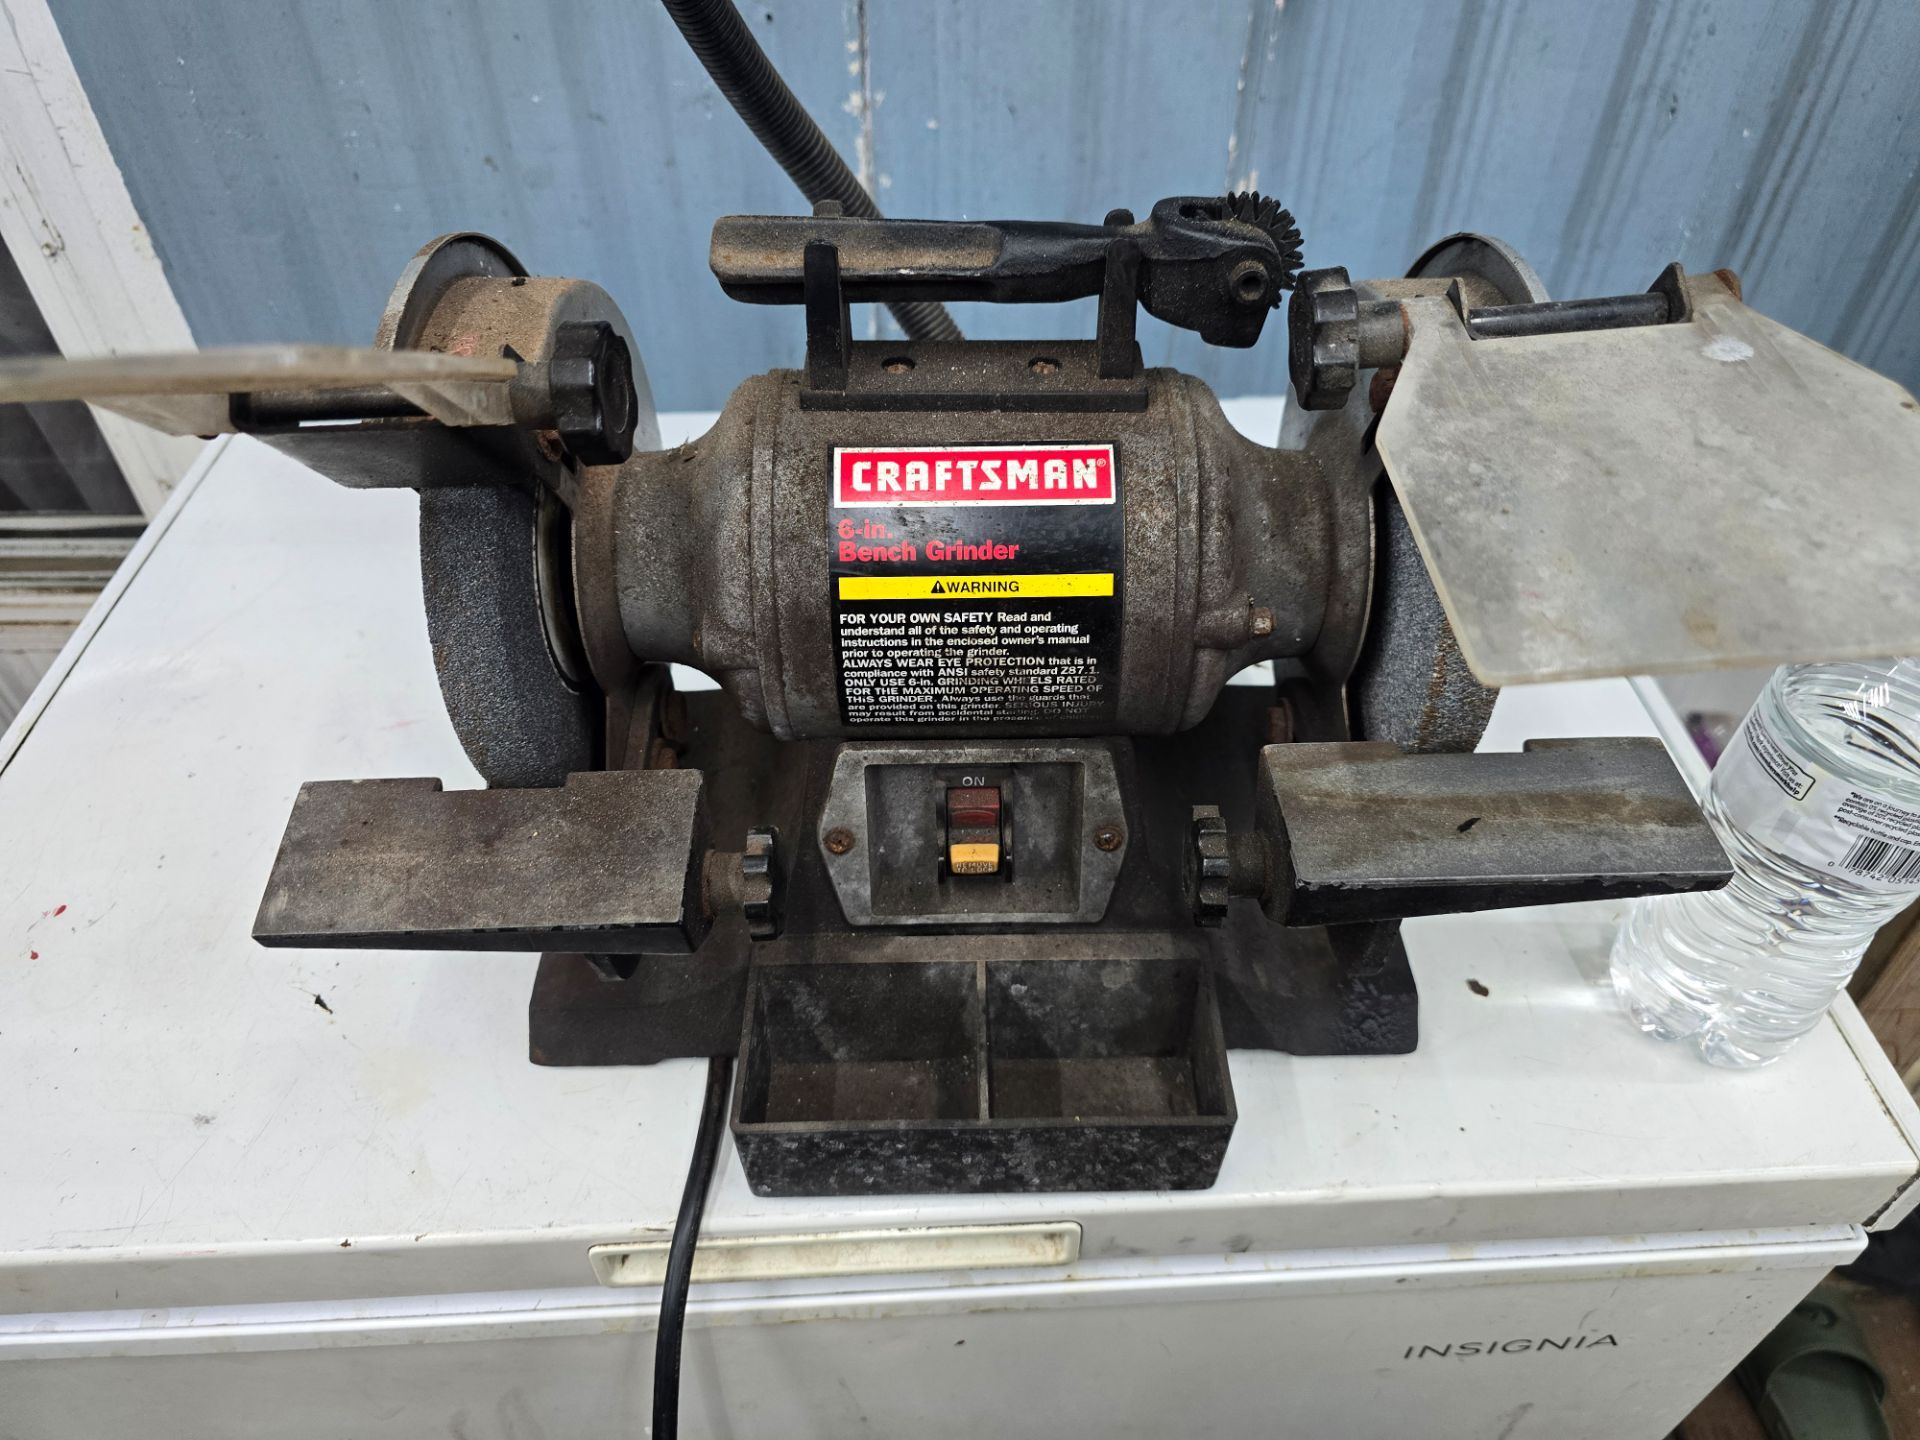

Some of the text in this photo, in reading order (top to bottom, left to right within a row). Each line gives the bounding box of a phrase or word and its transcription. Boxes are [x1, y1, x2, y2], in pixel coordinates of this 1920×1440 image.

[838, 519, 893, 539] 6-in.
[839, 540, 1019, 562] Bench Grinder
[947, 581, 1020, 593] WARNING
[840, 612, 1051, 624] FOR YOUR OWN SAFETY Read and
[841, 624, 1079, 636] understand all of the safety and operating
[841, 635, 1090, 647] instructions in the enclosed owner's manual
[842, 647, 1009, 659] prior to operating the grinder.
[843, 657, 1097, 668] ALWAYS WEAR EYE PROTECTION that is in
[844, 669, 907, 678] compliance
[938, 668, 967, 676] ANSI
[971, 668, 1005, 677] safety
[1009, 667, 1058, 675] standard
[880, 678, 905, 686] USE
[908, 678, 933, 686] 6-in.
[1057, 676, 1096, 684] RATED
[962, 776, 985, 786] ON
[1403, 1334, 1618, 1359] INSIGNIA
